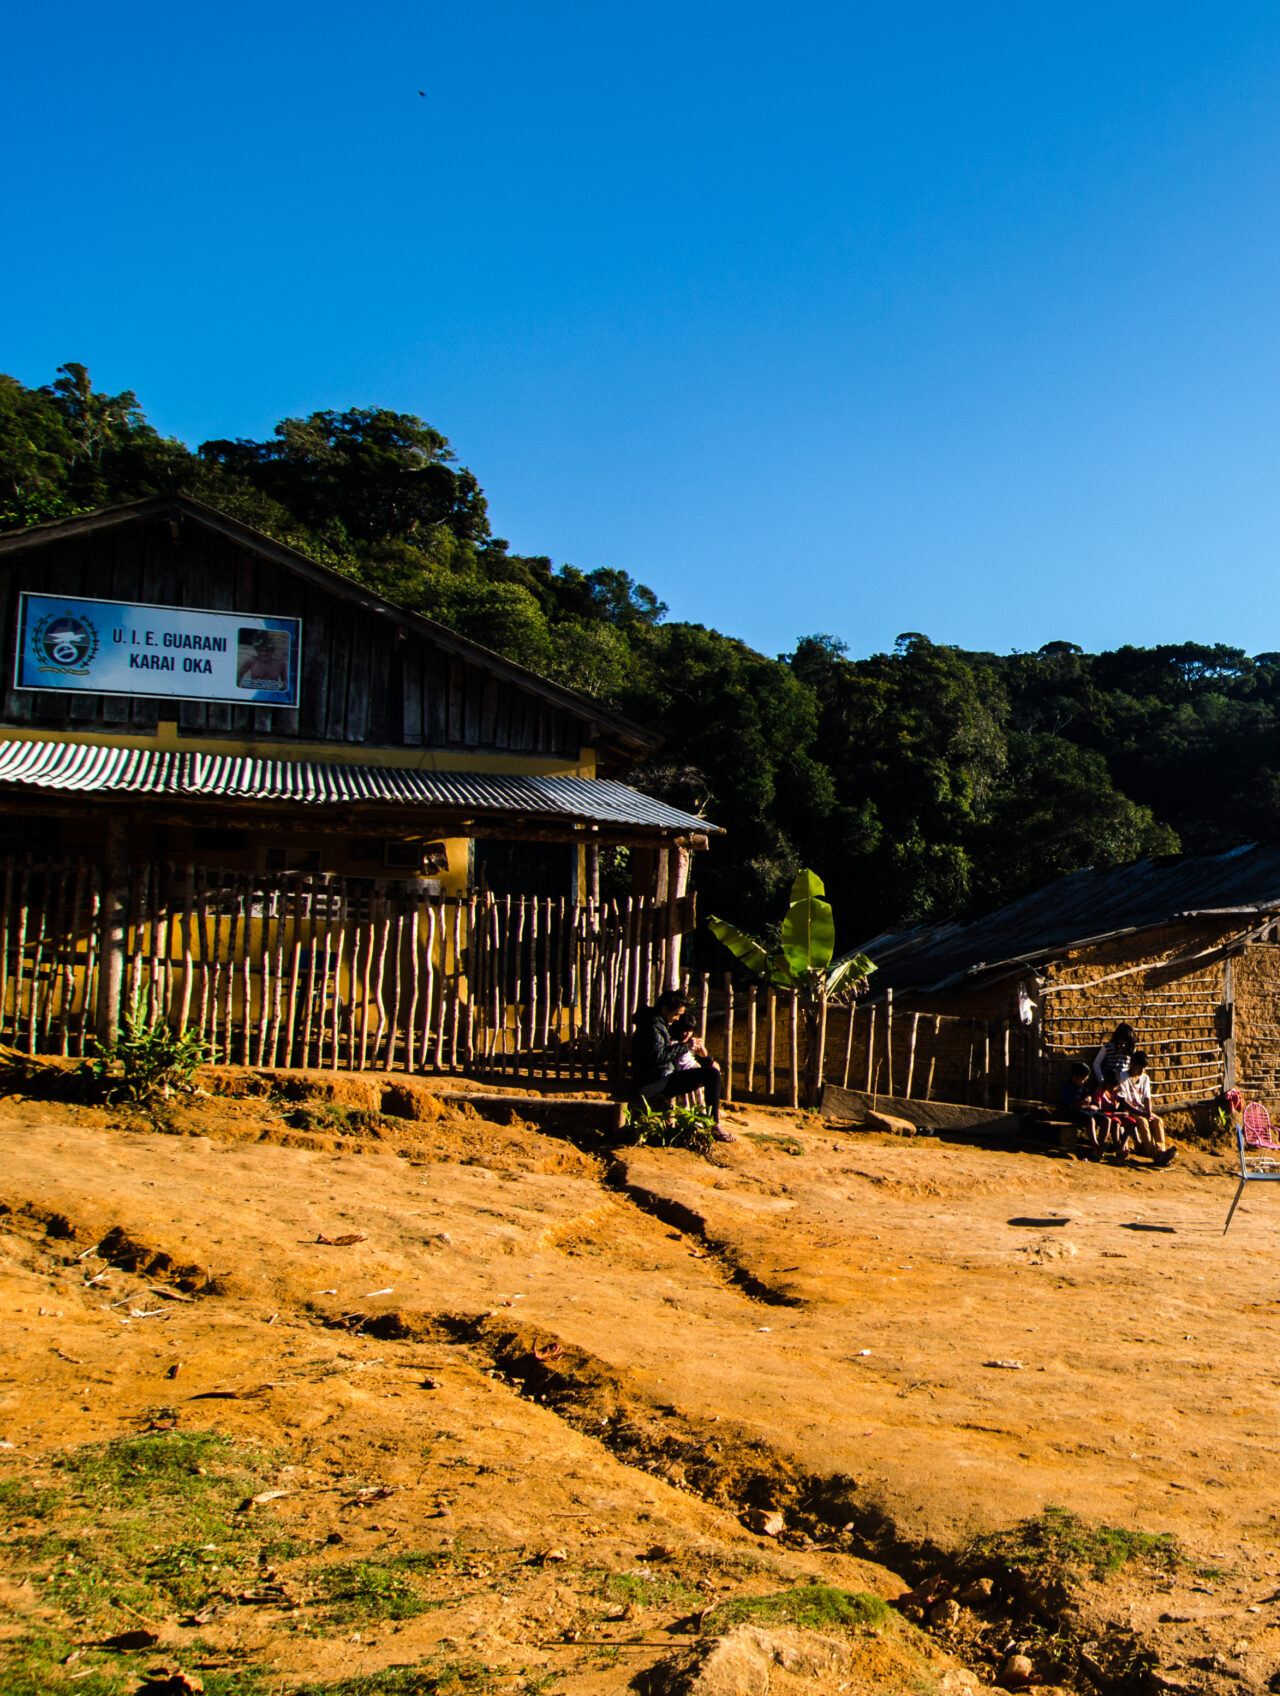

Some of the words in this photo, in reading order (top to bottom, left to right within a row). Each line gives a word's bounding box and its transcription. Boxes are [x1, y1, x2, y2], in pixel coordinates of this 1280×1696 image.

[113, 628, 127, 644] U.
[131, 629, 140, 645] I.
[145, 631, 158, 646] E.
[163, 632, 227, 652] GUARANI
[129, 653, 175, 671] KARAI
[183, 657, 213, 674] OKA
